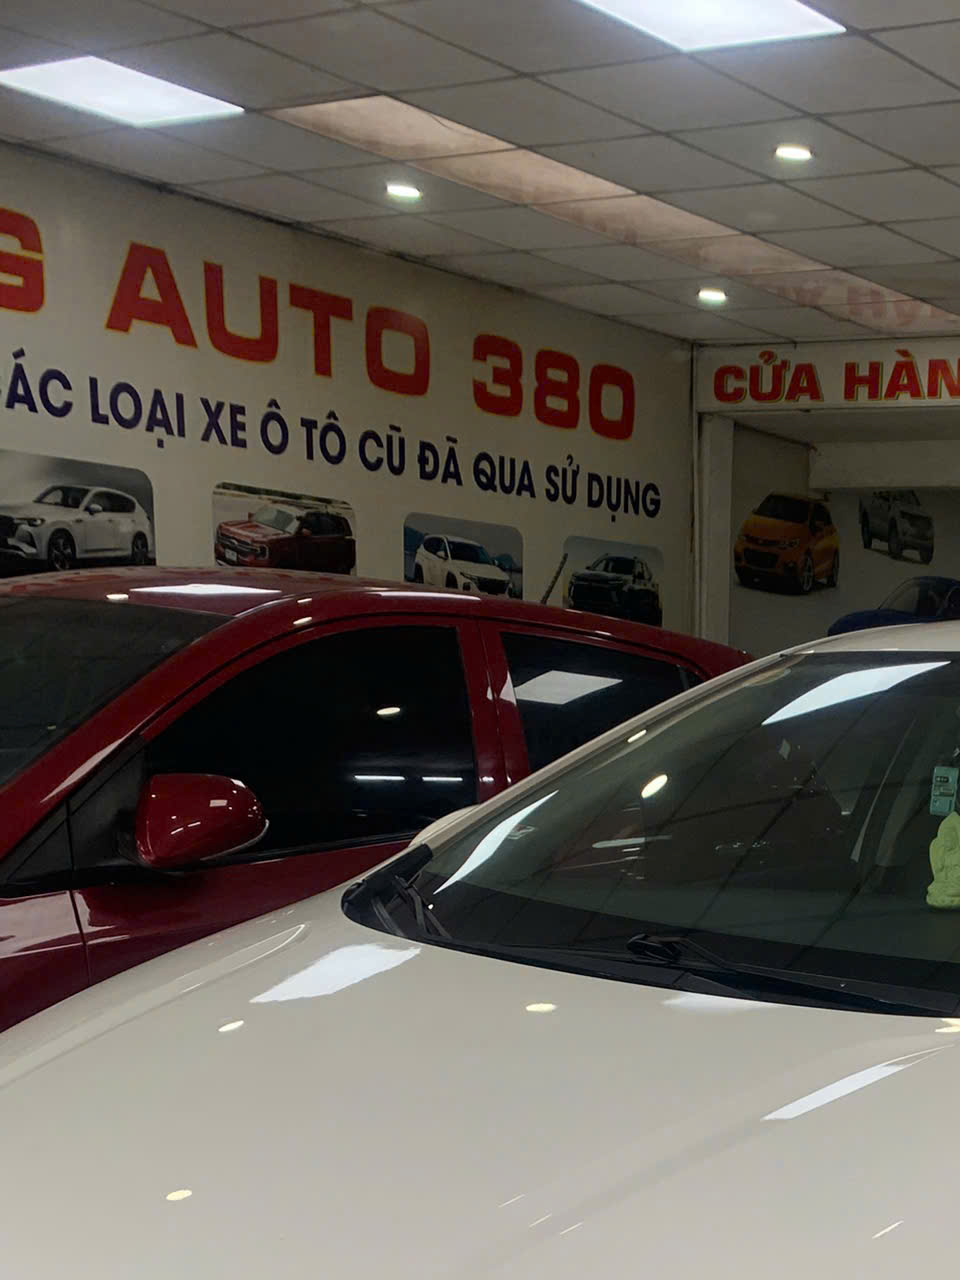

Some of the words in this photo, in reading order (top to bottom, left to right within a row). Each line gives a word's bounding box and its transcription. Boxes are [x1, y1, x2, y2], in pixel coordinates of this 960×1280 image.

[106, 242, 430, 397] AUTO
[472, 333, 636, 441] 380
[713, 349, 822, 403] CỬA
[0, 347, 73, 418] ÁC
[89, 377, 187, 449] LOẠI
[200, 397, 247, 449] XE
[260, 398, 289, 455] Ô
[300, 410, 347, 465] TÔ
[358, 424, 406, 476] CŨ
[417, 435, 463, 487] ĐÃ
[472, 451, 537, 499] QUA
[545, 454, 581, 505] SỬ
[586, 471, 662, 523] DỤNG
